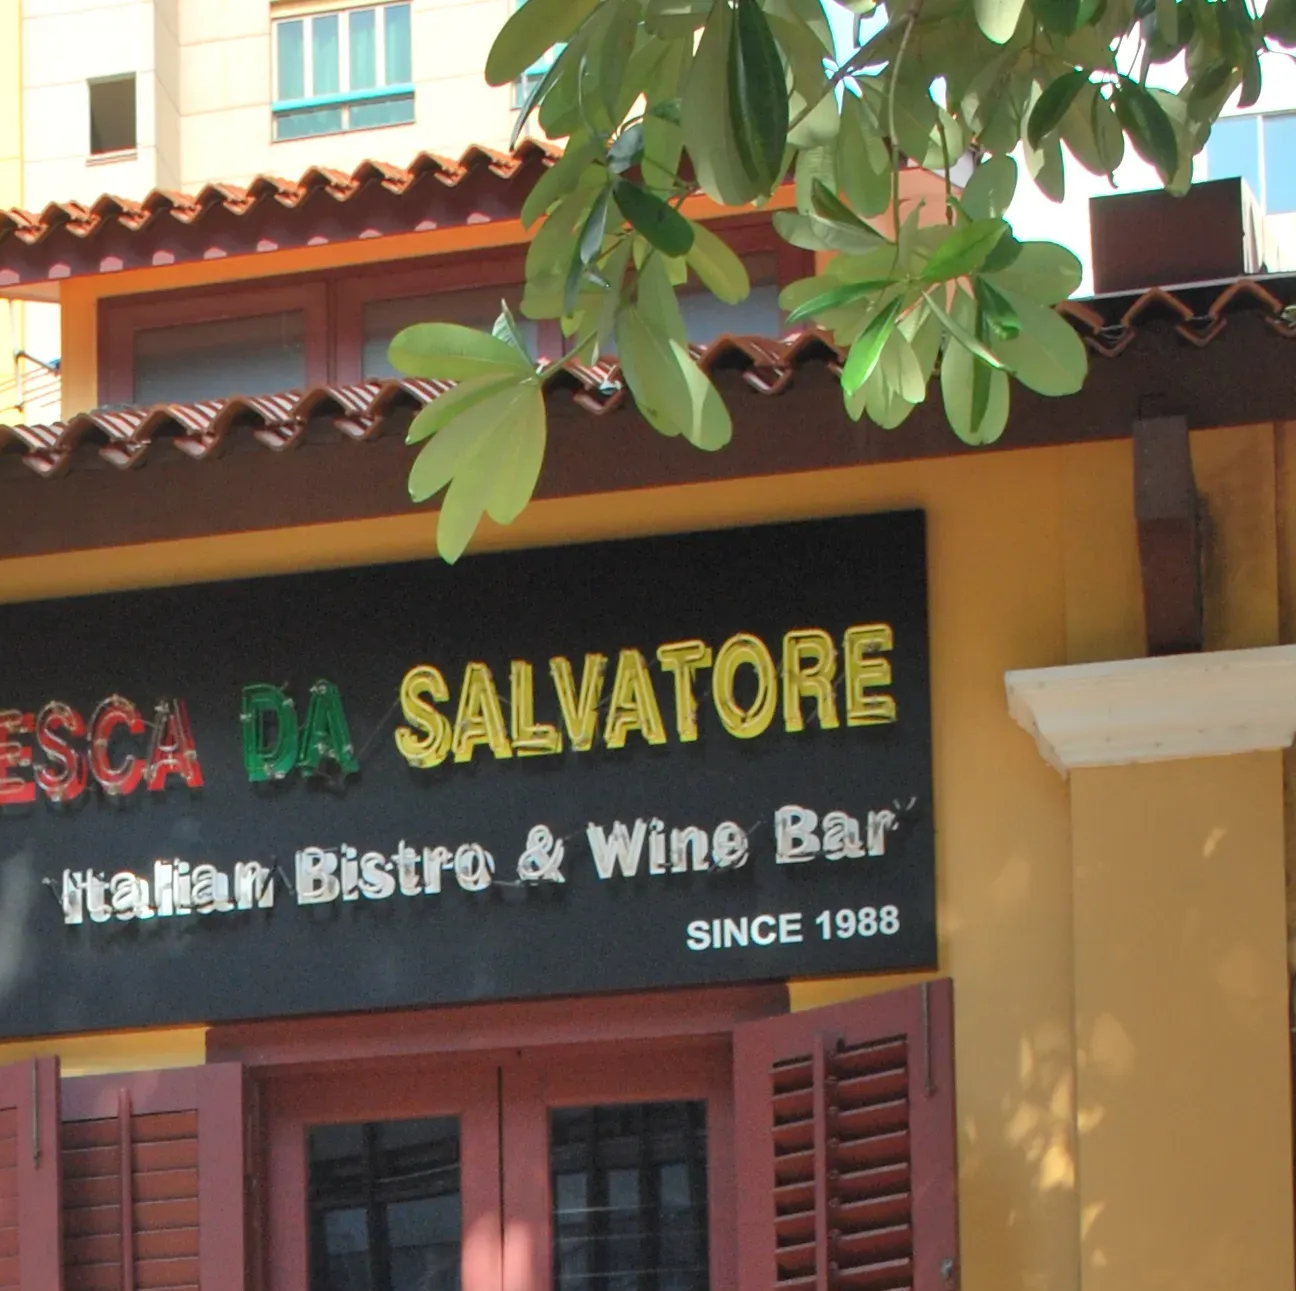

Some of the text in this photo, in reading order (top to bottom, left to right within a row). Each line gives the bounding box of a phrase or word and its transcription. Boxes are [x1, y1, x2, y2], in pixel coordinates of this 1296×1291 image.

[240, 679, 361, 783] DA
[395, 623, 897, 769] SALVATORE
[62, 804, 901, 925] Italian Bistro & Wine Bar
[685, 904, 901, 951] SINCE 1988
